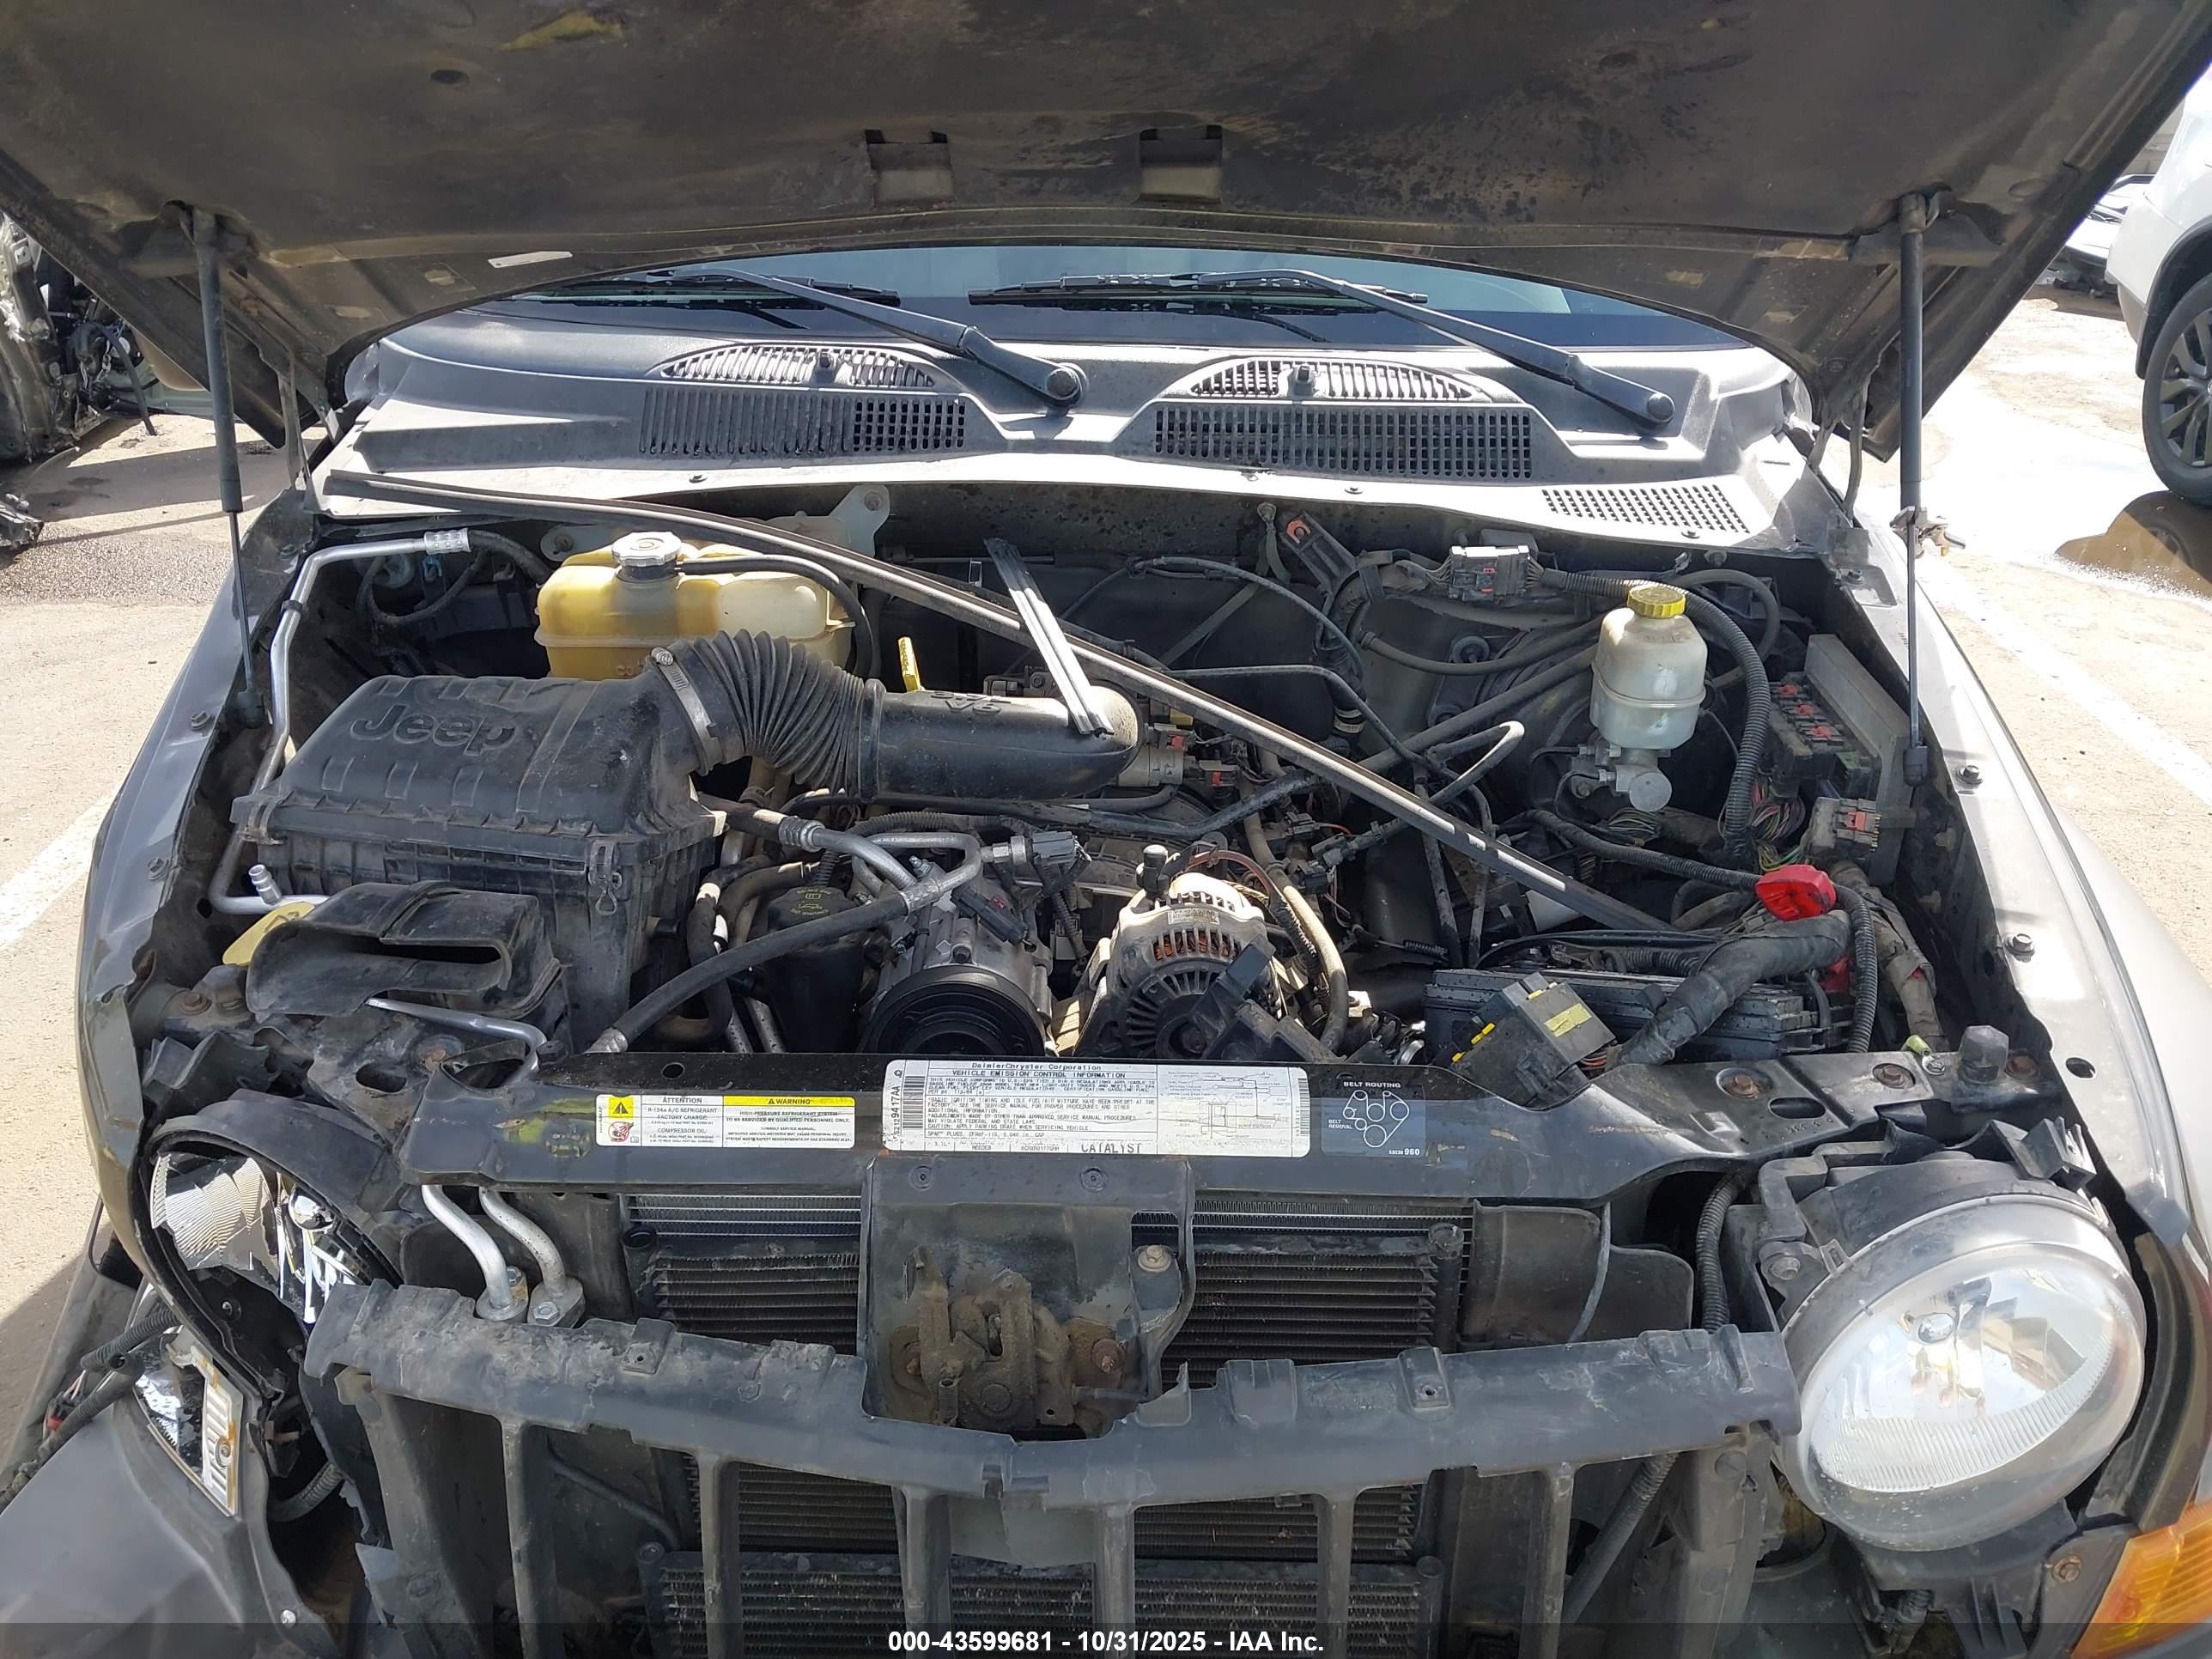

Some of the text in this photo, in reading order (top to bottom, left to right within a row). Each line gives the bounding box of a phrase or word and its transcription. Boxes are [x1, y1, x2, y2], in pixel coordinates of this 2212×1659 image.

[945, 700, 1001, 713] V6
[350, 703, 519, 757] Jeep
[972, 1062, 1043, 1071] DaimlerChrysler
[1081, 1142, 1142, 1153] CATALYST
